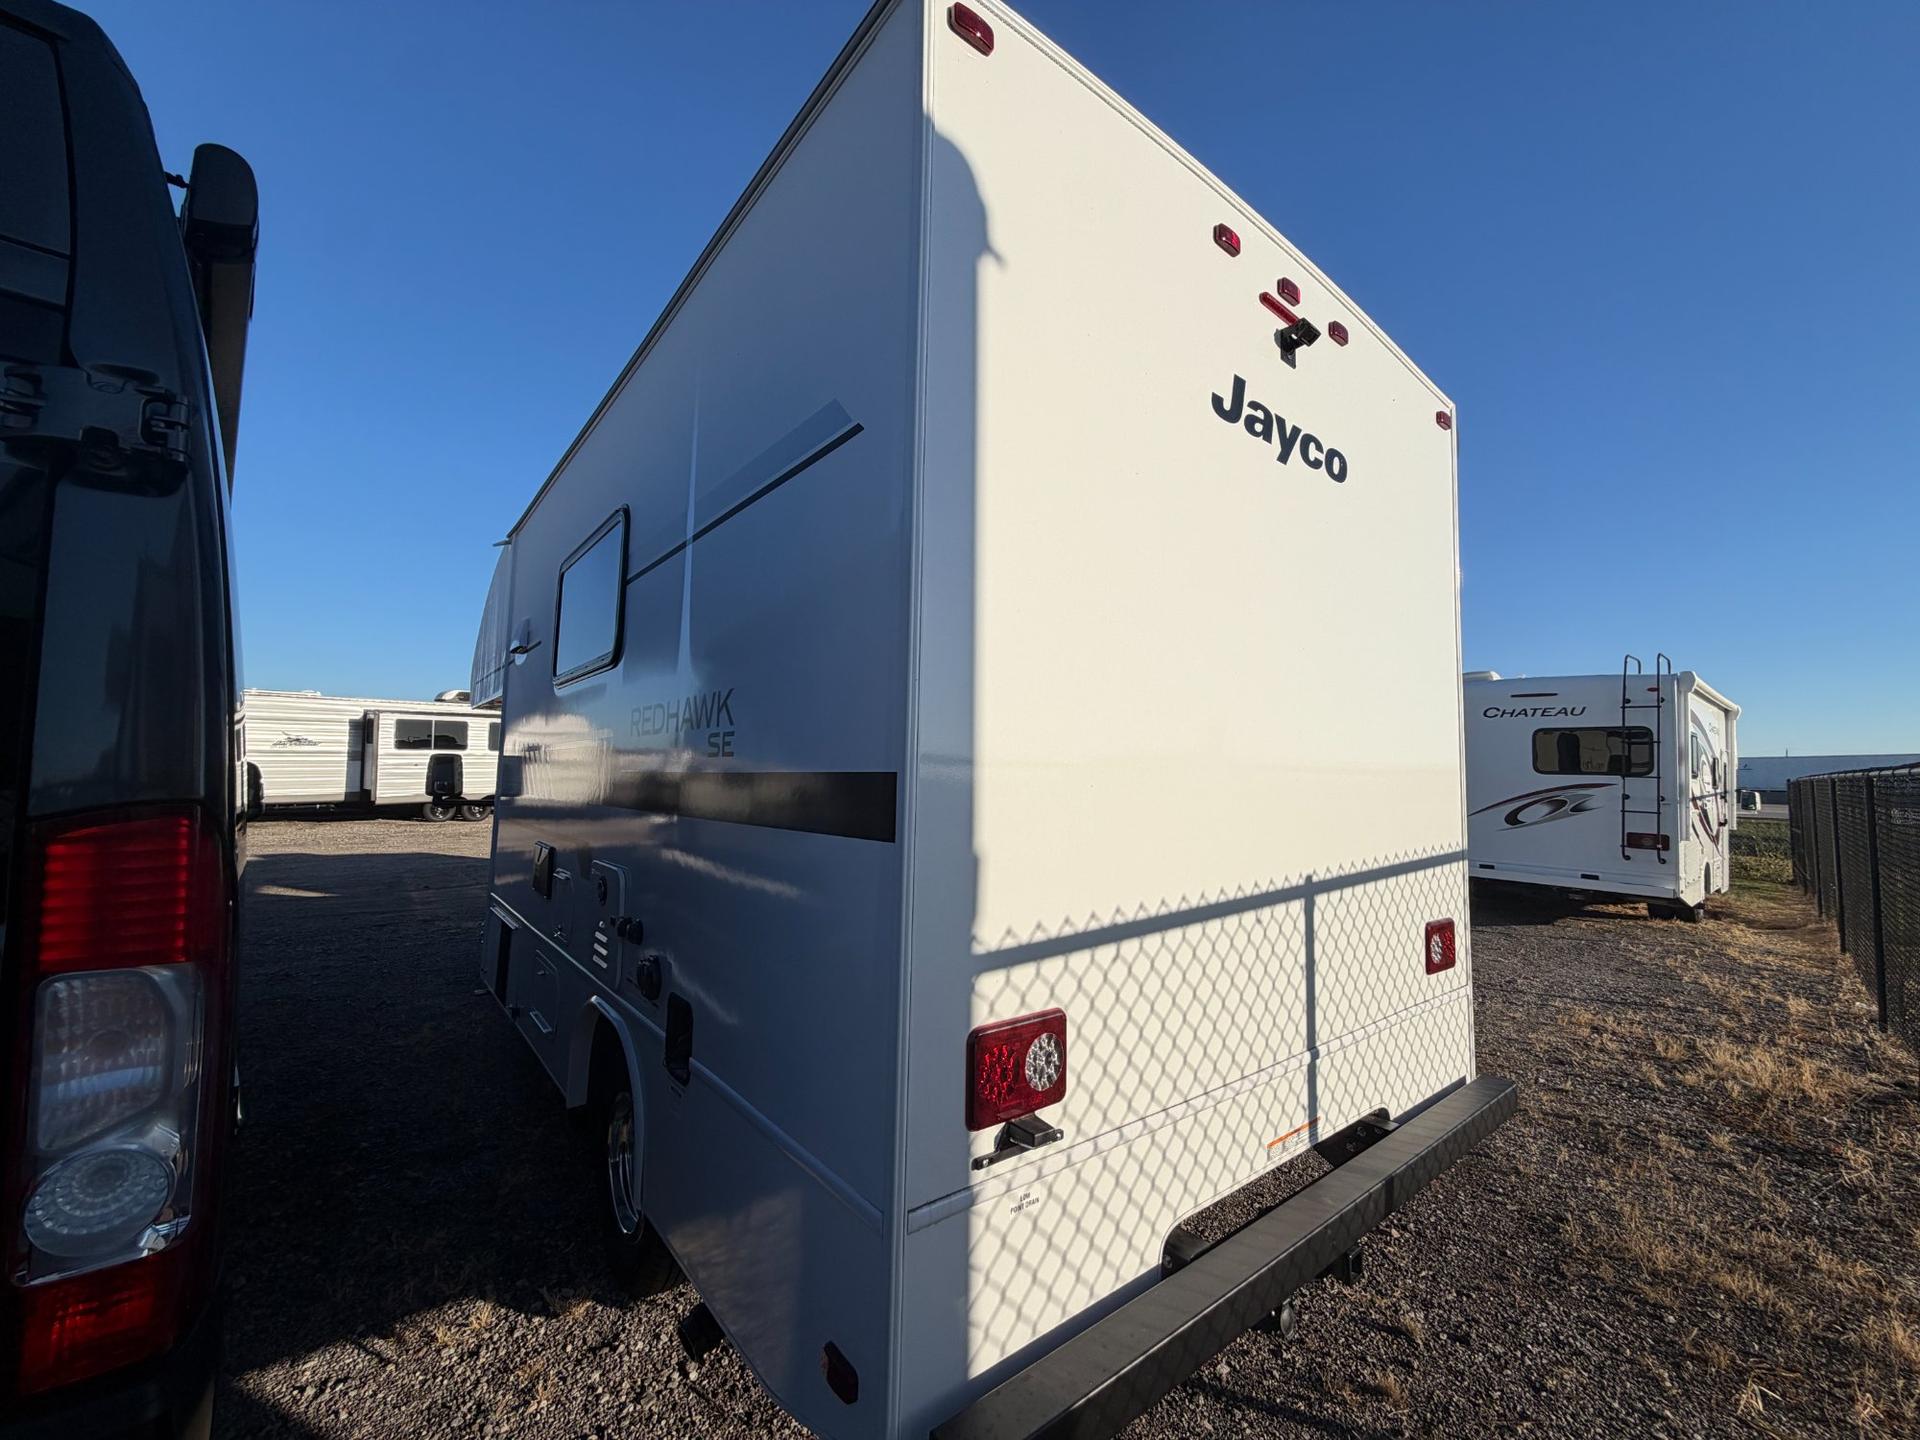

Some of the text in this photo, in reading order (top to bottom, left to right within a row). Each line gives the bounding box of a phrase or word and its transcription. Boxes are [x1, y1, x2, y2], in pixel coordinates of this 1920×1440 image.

[1211, 374, 1348, 484] Jayco
[630, 688, 735, 737] REDHAWK
[1482, 706, 1587, 719] CHATEAU
[707, 731, 735, 758] SE
